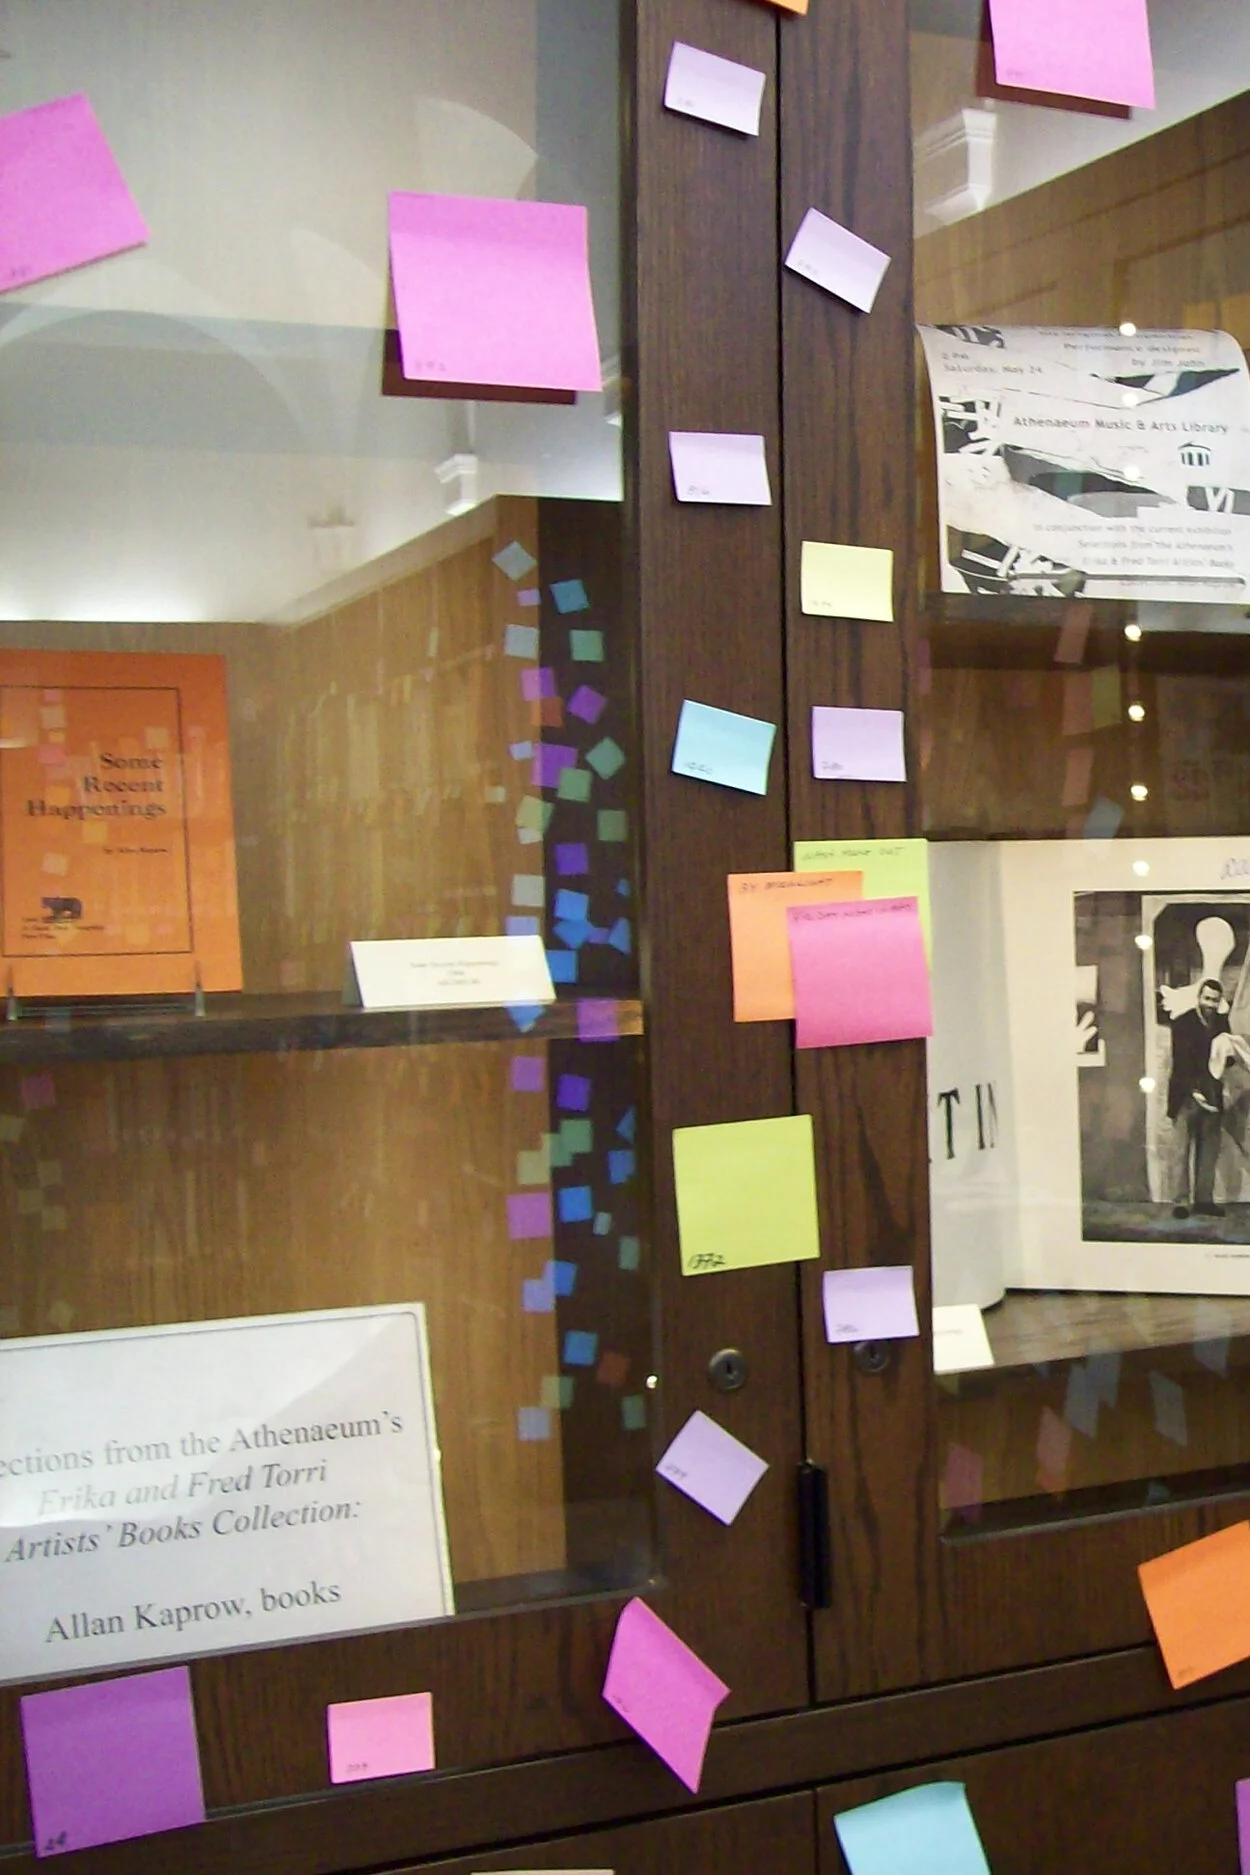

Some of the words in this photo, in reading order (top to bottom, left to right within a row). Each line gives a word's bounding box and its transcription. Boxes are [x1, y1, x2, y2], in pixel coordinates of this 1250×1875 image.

[1013, 416, 1090, 428] Athenaeum
[1095, 419, 1130, 430] Music
[1151, 421, 1177, 431] Arts
[1182, 421, 1228, 433] Library
[100, 752, 162, 770] Some
[82, 776, 163, 793] Recent
[26, 799, 167, 820] Happenings
[104, 1440, 171, 1466] from
[181, 1432, 220, 1457] the
[228, 1410, 403, 1452] Athenaeum's
[37, 1481, 115, 1517] Erika
[125, 1475, 178, 1505] and
[187, 1466, 252, 1500] Fred
[261, 1459, 327, 1489] Torri
[4, 1524, 113, 1563] Artists'
[118, 1515, 201, 1549] Books
[212, 1501, 360, 1537] Collection:
[45, 1611, 124, 1644] Allan
[133, 1599, 252, 1633] Kaprow,
[260, 1581, 342, 1612] books
